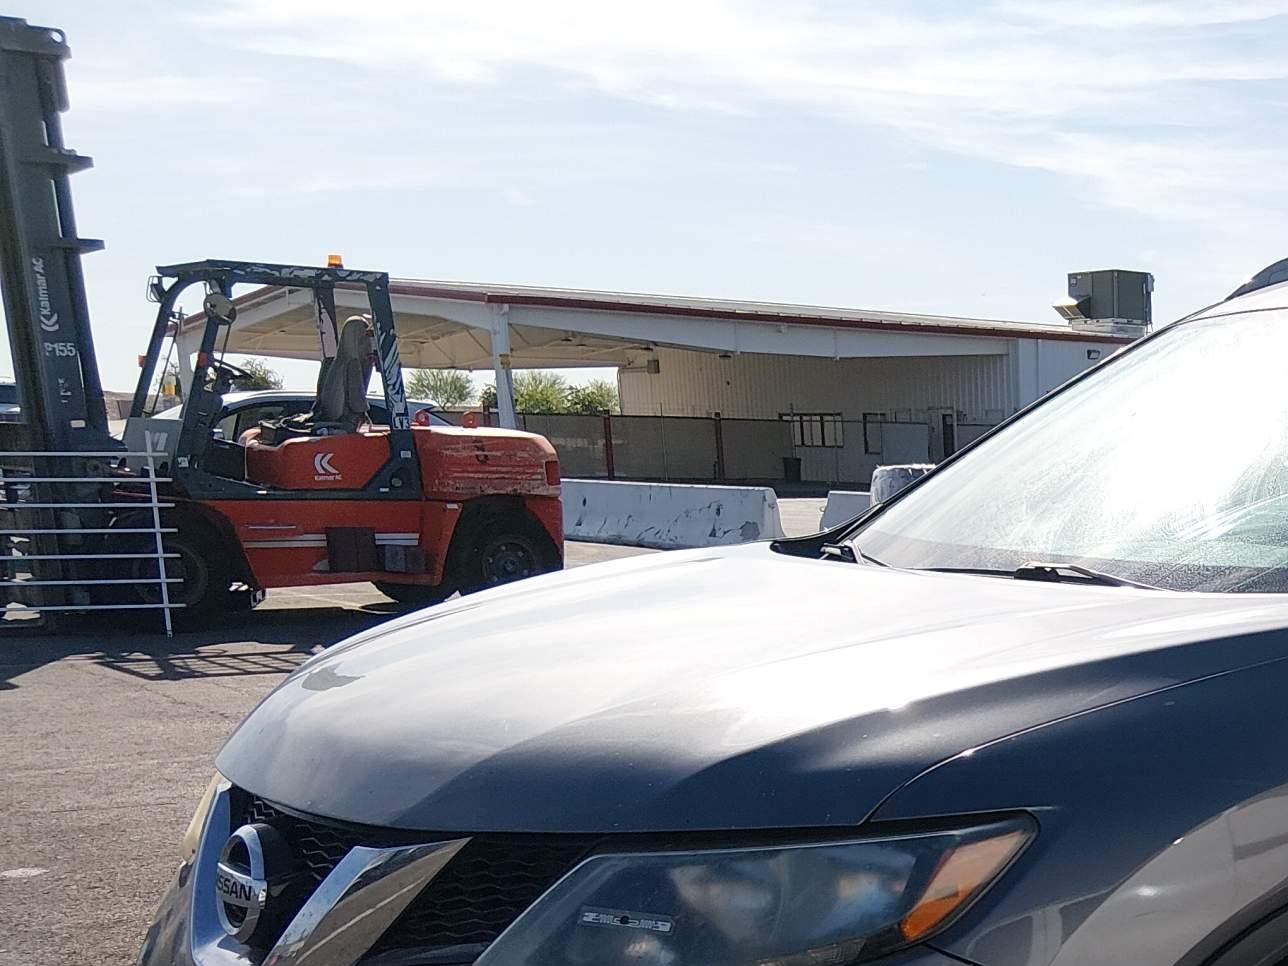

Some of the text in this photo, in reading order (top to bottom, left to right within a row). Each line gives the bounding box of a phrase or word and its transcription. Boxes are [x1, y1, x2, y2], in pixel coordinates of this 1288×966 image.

[32, 257, 51, 315] Kalmar AC
[216, 874, 252, 901] SSAN
